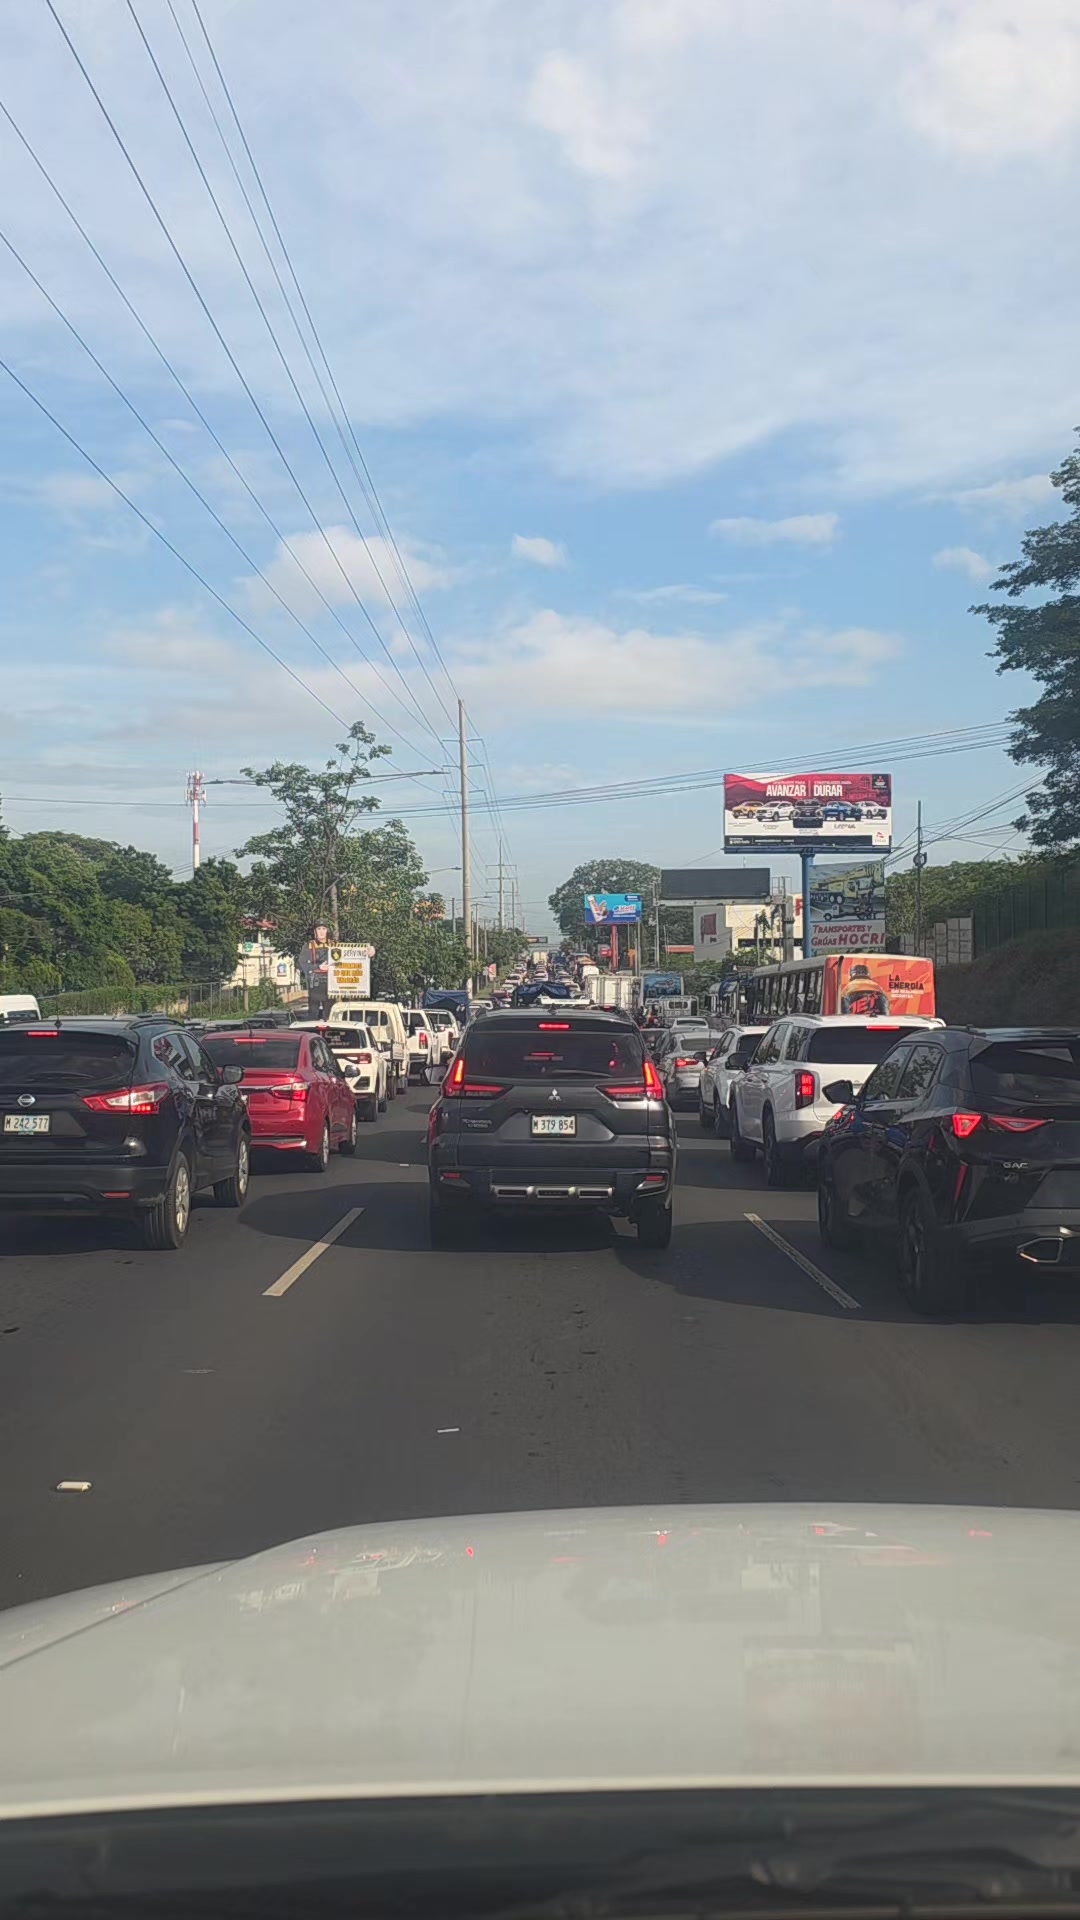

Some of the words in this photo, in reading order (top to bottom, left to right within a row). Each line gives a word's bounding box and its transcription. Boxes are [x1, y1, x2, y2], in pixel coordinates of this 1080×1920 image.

[766, 785, 806, 797] AVANZAR
[813, 785, 843, 797] DURAR
[813, 924, 866, 934] TRANSPORTES
[5, 1117, 11, 1129] M
[13, 1117, 30, 1129] 242
[32, 1117, 48, 1129] 577
[533, 1120, 539, 1131] M
[540, 1120, 556, 1131] 379
[559, 1120, 574, 1131] 854
